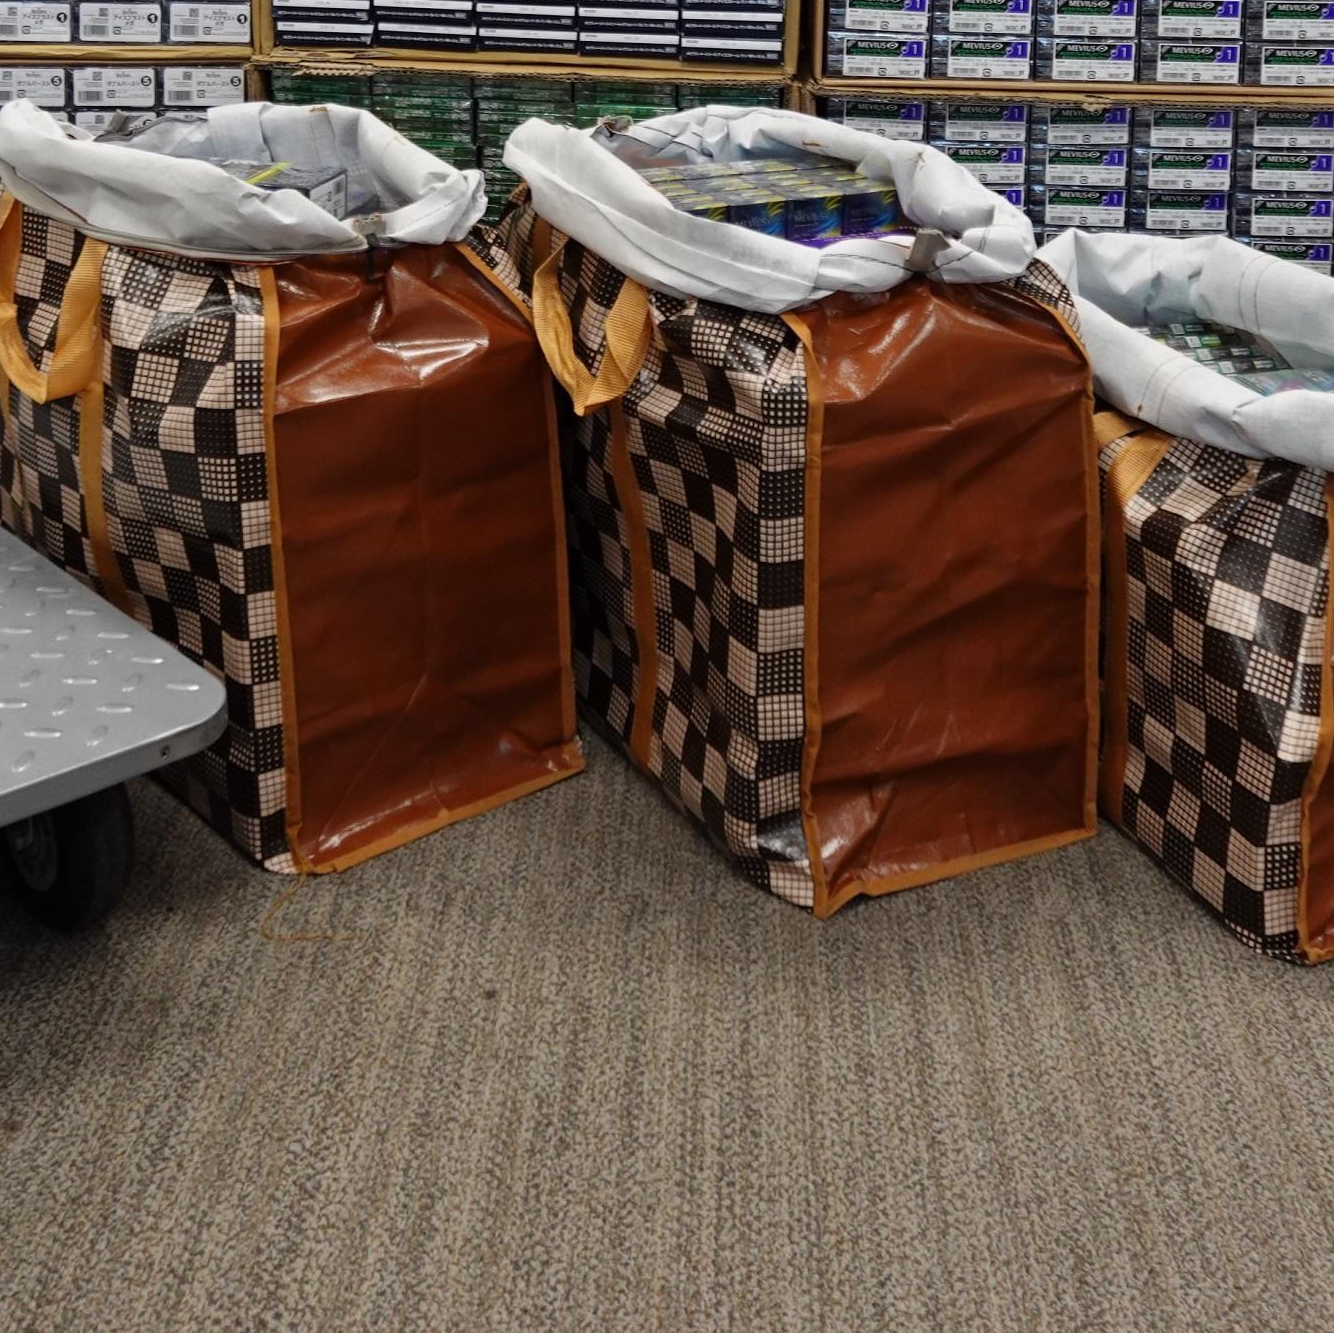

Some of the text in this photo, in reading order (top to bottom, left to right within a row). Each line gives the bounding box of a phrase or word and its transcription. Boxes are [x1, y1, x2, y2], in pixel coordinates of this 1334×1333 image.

[857, 40, 888, 50] MEVIUS
[962, 41, 993, 51] MEVIUS
[1066, 43, 1097, 53] MEVIUS
[1171, 45, 1202, 55] MEVIUS
[1275, 48, 1306, 58] MEVIUS
